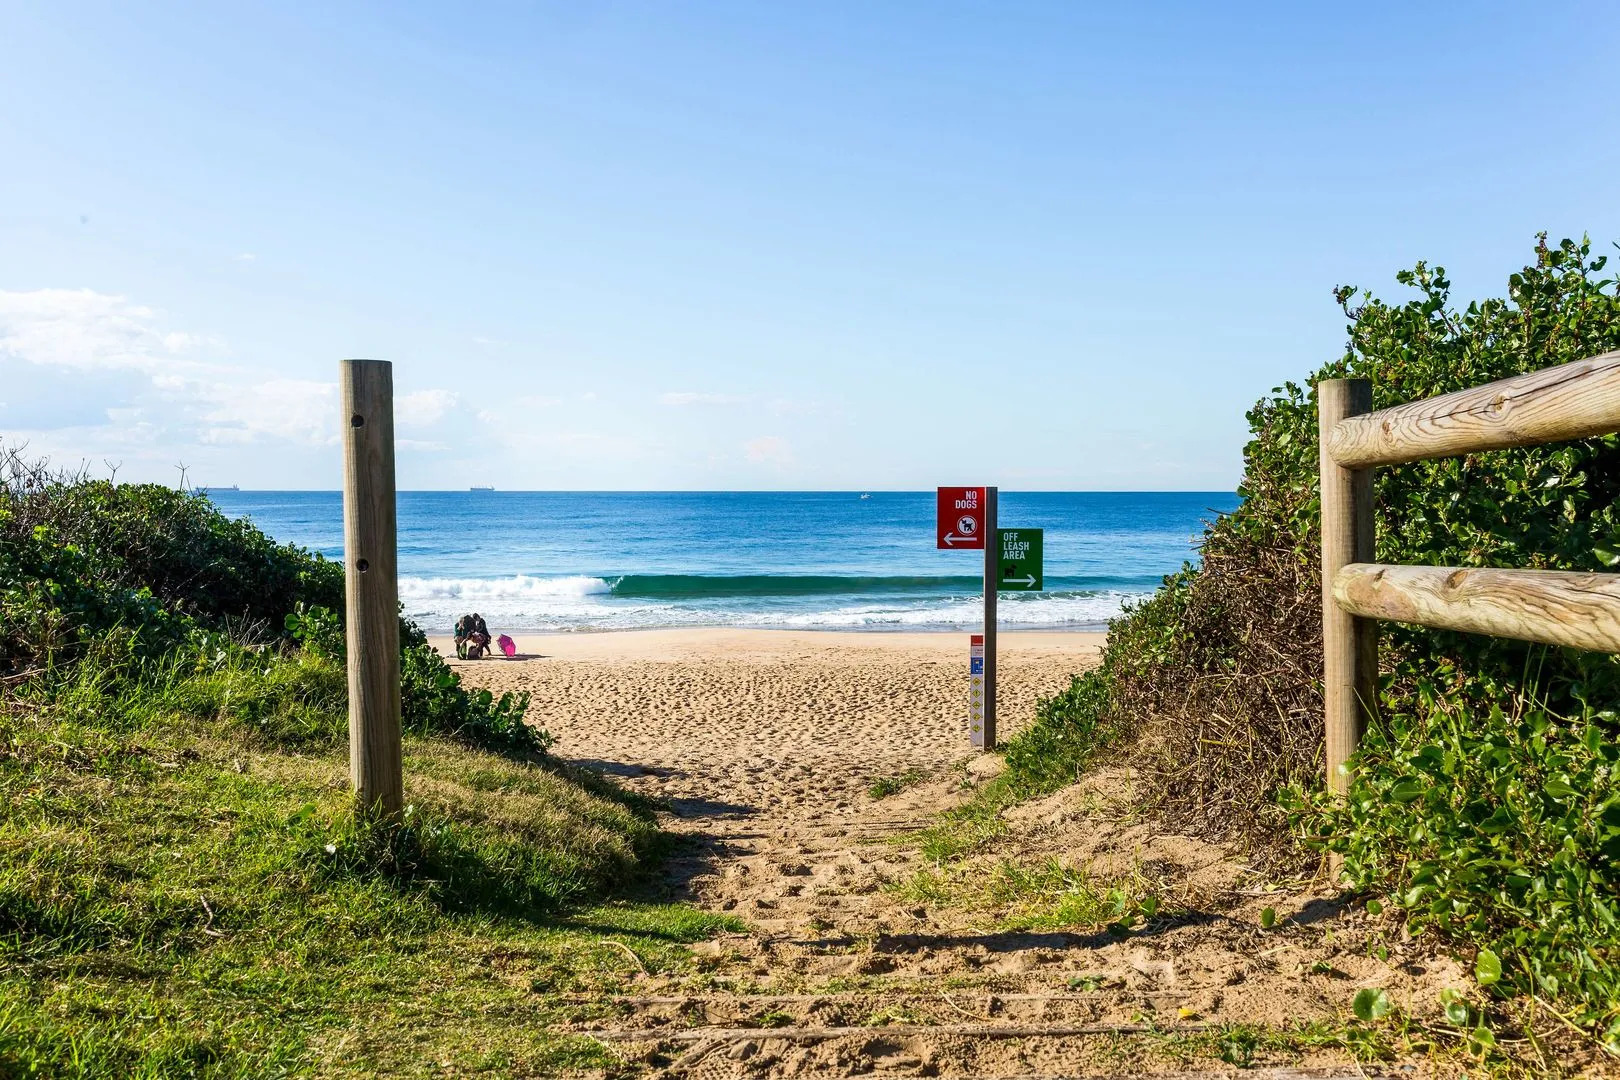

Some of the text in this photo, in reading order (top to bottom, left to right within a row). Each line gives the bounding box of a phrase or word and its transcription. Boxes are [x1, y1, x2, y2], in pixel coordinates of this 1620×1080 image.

[966, 491, 977, 500] NO
[955, 500, 977, 509] DOGS
[1003, 532, 1018, 541] OFF
[1003, 542, 1030, 551] LEASH
[1003, 551, 1026, 560] AREA
